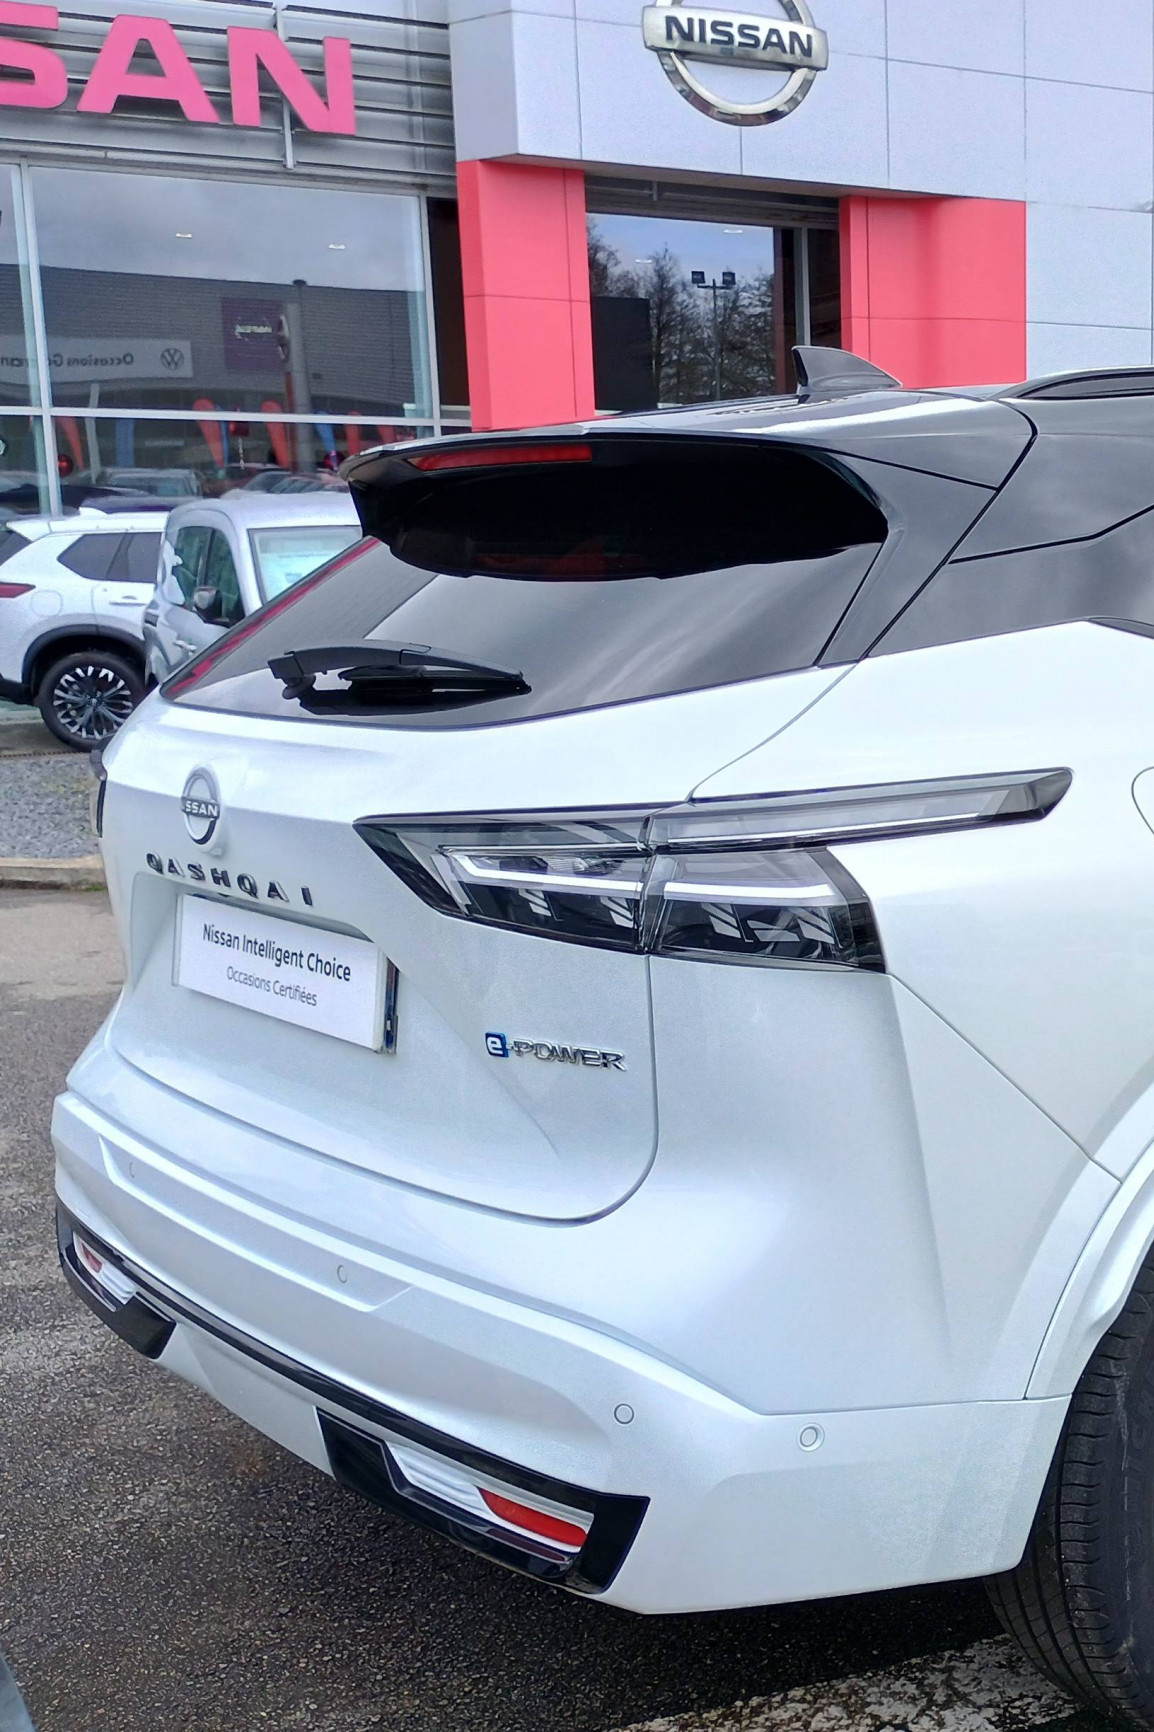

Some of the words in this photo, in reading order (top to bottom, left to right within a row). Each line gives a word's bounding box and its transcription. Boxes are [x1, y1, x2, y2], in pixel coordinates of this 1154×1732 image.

[665, 16, 813, 58] NISSAN
[146, 852, 314, 907] QASHQAI
[203, 923, 240, 950] Nissan
[242, 934, 303, 969] Intelligent
[307, 953, 351, 982] Choice
[226, 965, 271, 993] Occasions
[272, 980, 317, 1006] Certifiées
